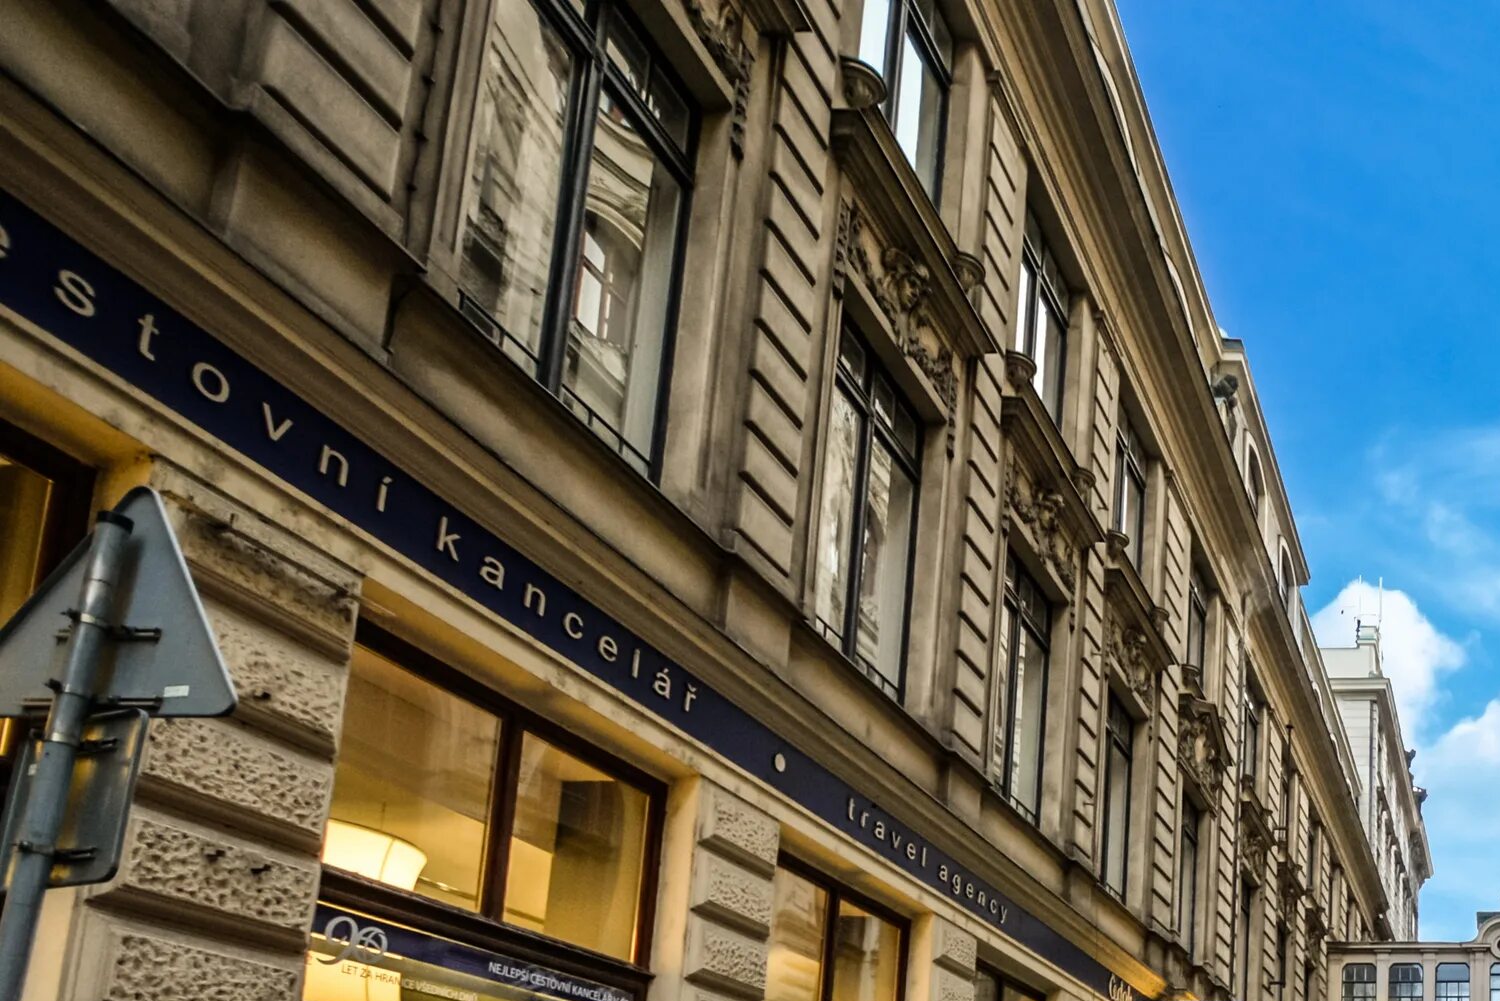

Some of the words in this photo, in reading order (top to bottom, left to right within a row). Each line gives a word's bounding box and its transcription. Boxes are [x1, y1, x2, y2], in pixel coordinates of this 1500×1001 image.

[0, 222, 393, 512] stovní
[437, 515, 697, 713] kancelář
[848, 798, 927, 867] travel
[939, 864, 1008, 924] agency
[316, 916, 388, 965] 90
[341, 963, 358, 977] LET
[360, 967, 372, 980] ZA
[375, 971, 416, 990] HRANICE
[488, 961, 530, 983] NEJLEPŠÍ
[530, 973, 572, 993] CESTOVNÍ
